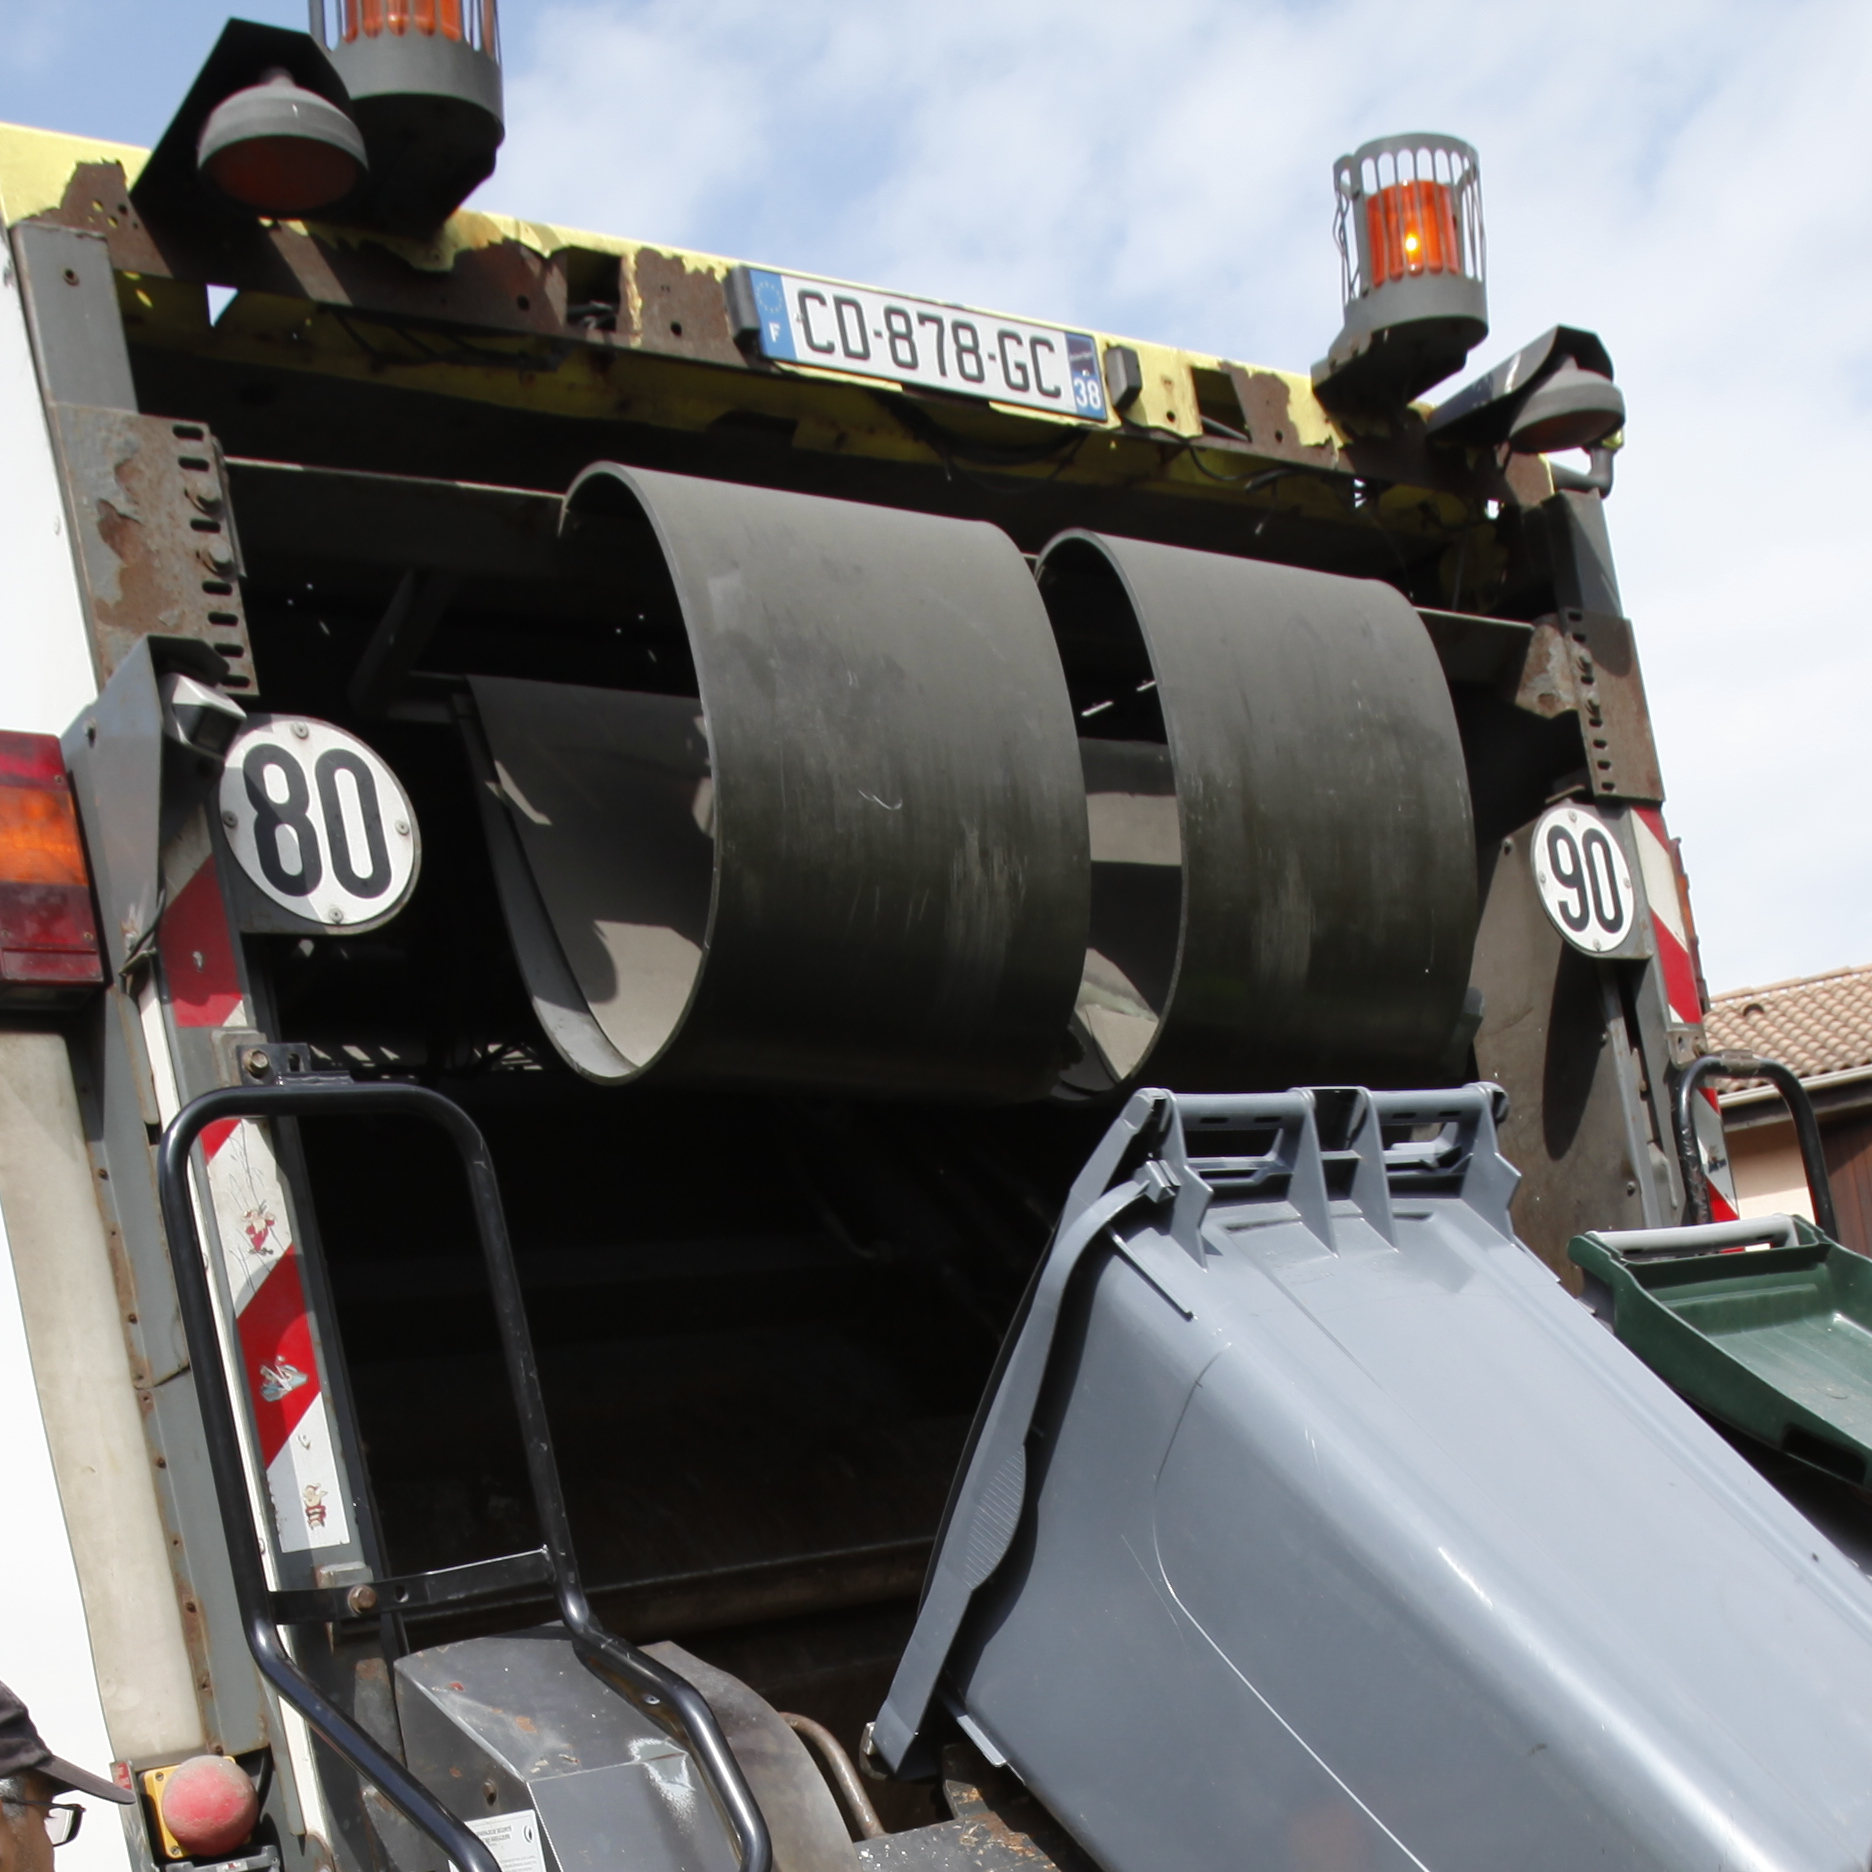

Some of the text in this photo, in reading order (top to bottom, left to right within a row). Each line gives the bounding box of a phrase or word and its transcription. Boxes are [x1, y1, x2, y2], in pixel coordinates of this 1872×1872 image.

[768, 321, 782, 343] F
[796, 289, 1061, 398] CD-878-GC
[1072, 377, 1102, 410] 38
[242, 743, 392, 899] 80
[1546, 824, 1624, 934] 90
